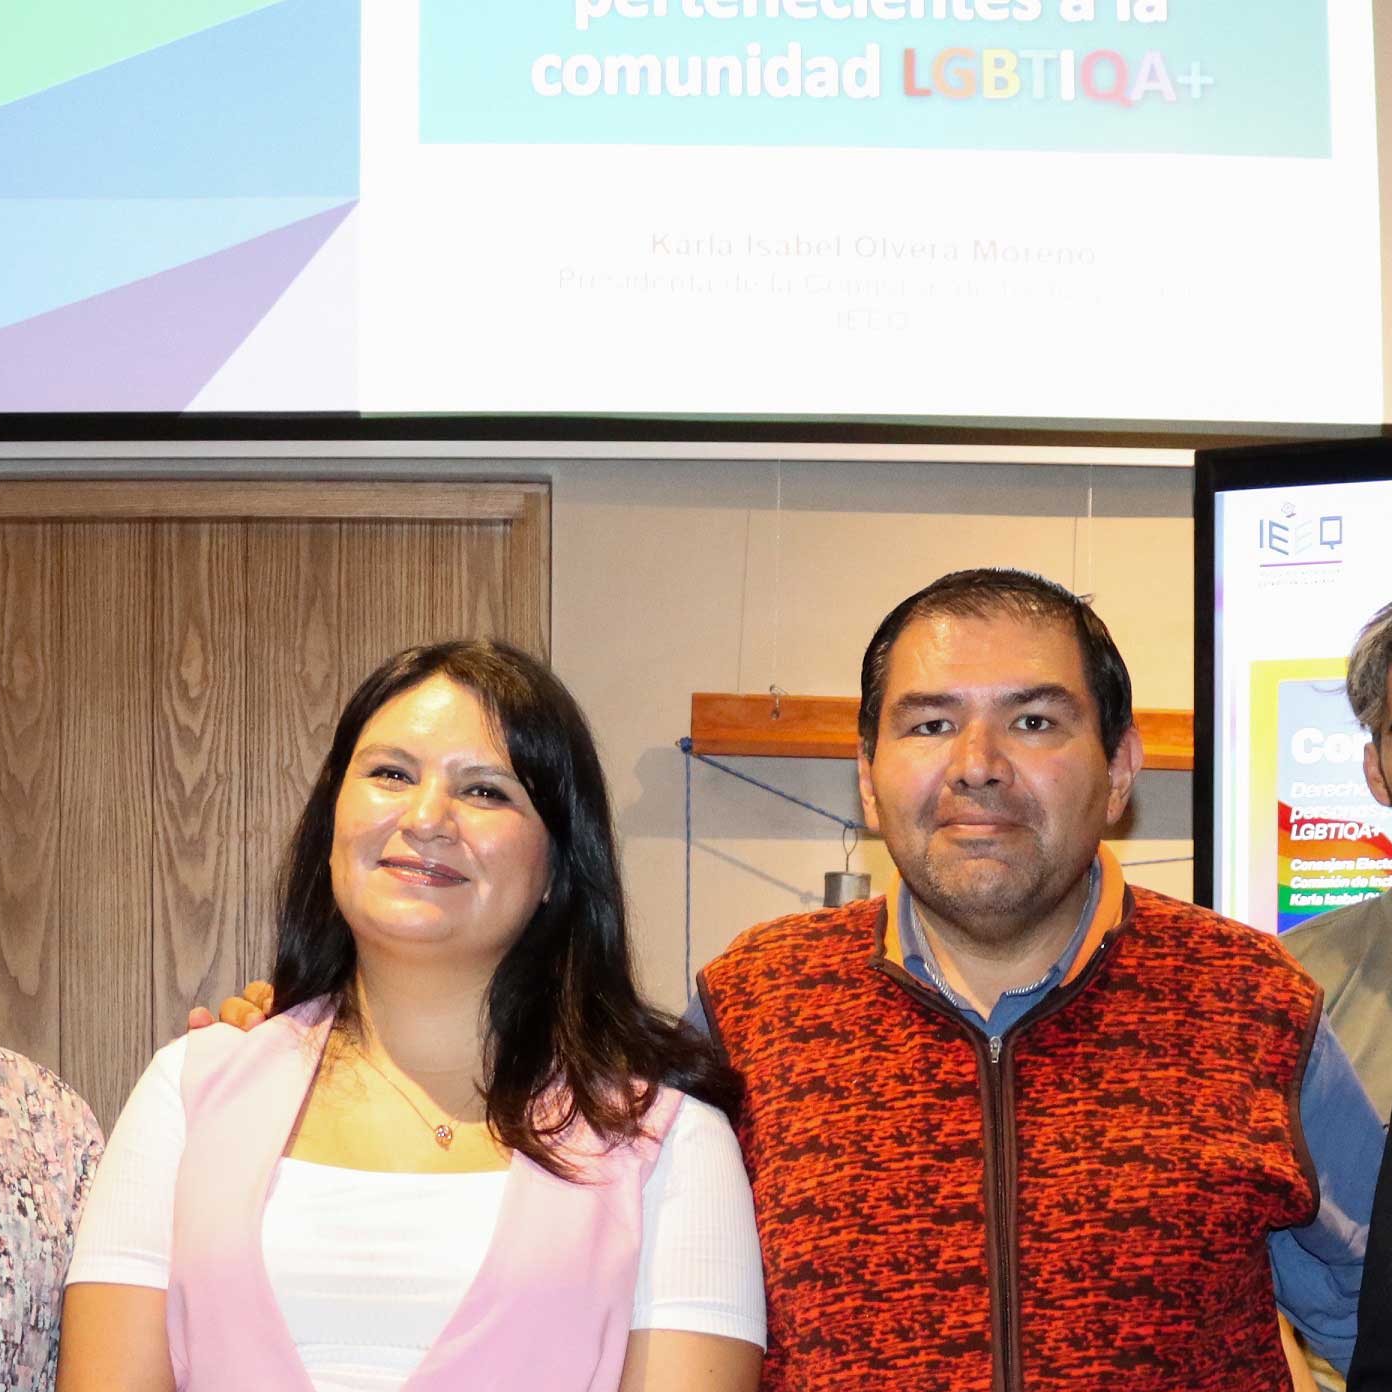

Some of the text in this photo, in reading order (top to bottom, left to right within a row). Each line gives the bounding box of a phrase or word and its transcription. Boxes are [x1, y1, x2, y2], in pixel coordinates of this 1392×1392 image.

[530, 42, 1215, 107] comunidad LGBTIQA+
[650, 232, 733, 256] Karla
[748, 232, 842, 256] Isabel
[854, 234, 959, 262] Olvera
